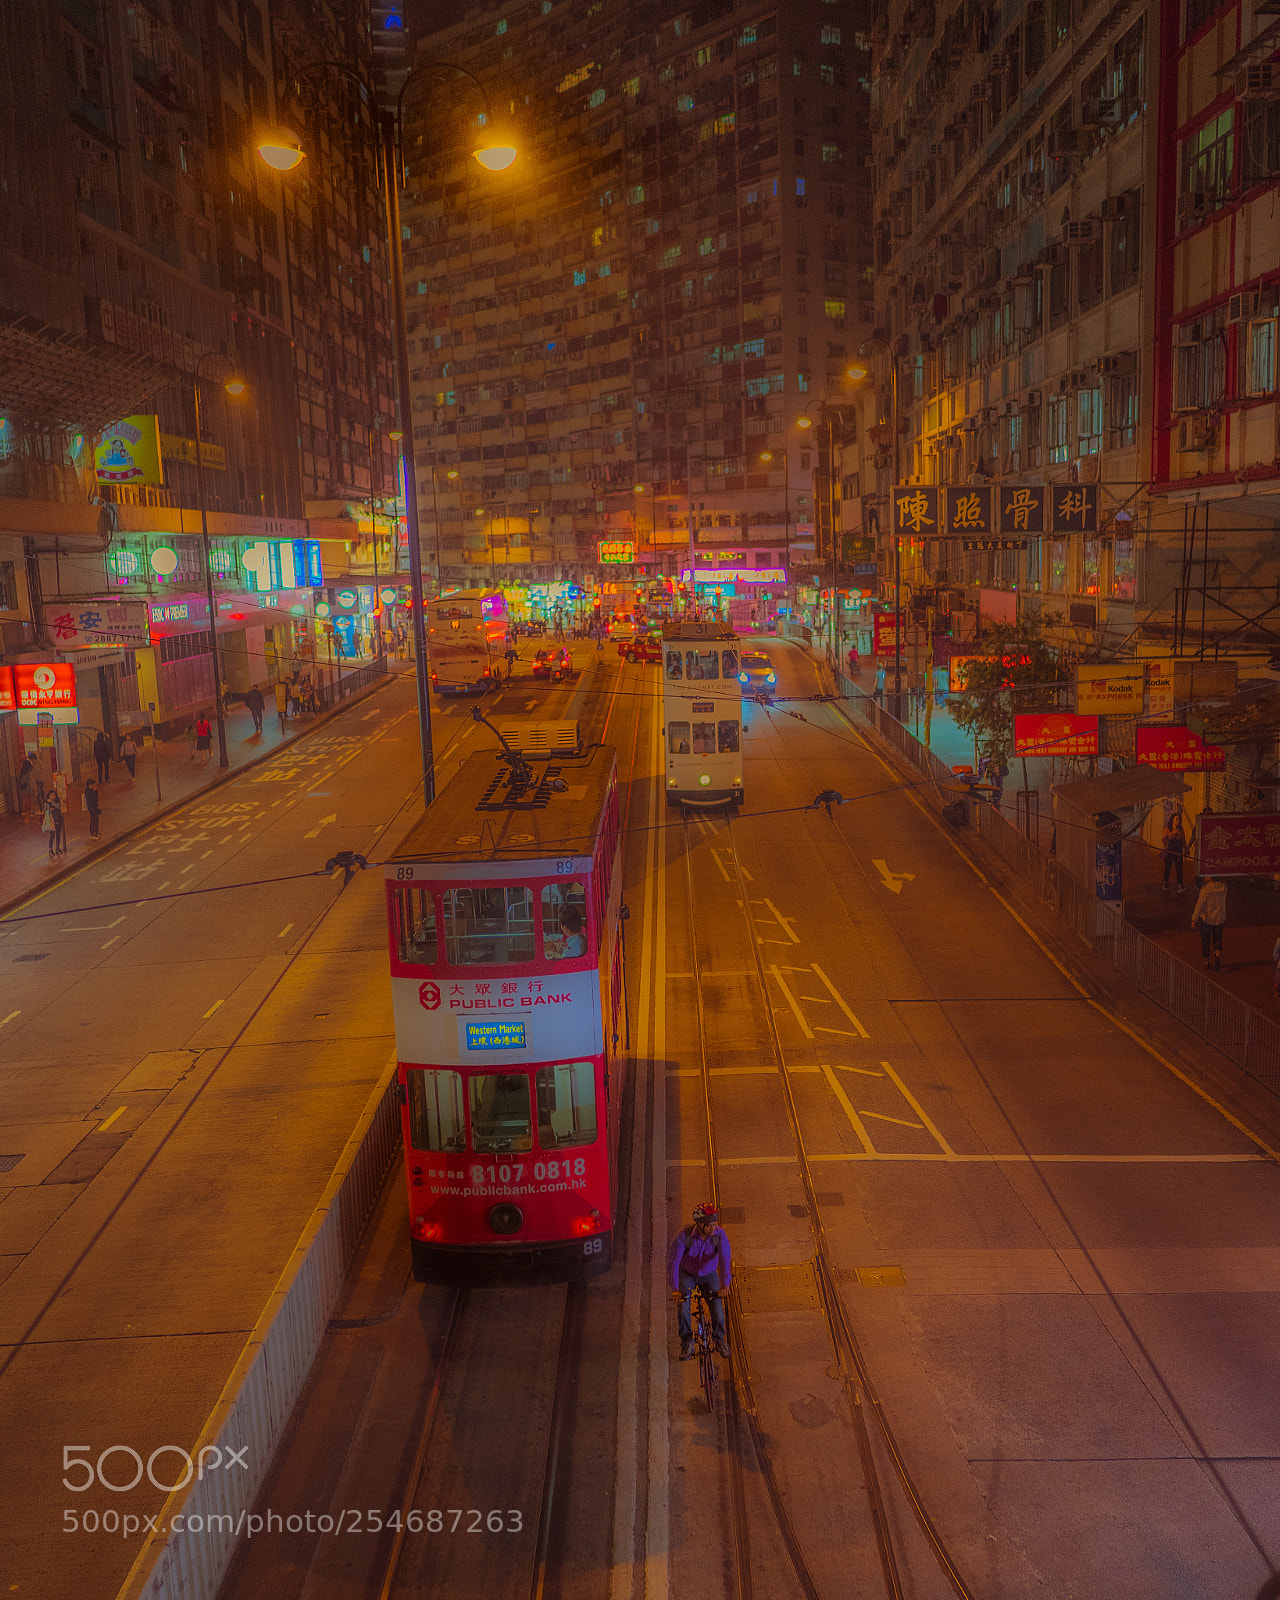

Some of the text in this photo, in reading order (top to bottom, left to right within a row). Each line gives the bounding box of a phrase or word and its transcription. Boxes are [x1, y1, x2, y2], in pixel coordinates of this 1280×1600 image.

[896, 488, 1092, 533] 陳照骨科
[695, 624, 708, 634] 31
[1108, 684, 1134, 692] Kodak
[1146, 679, 1171, 687] Kodak
[189, 801, 261, 816] BUS
[154, 815, 252, 833] STOP
[397, 867, 414, 880] 89
[556, 861, 573, 875] 89
[449, 980, 544, 997] 大眾銀行
[449, 992, 573, 1010] PUBLIC BANK
[468, 1024, 525, 1036] Western Market
[471, 1163, 525, 1184] 8107
[533, 1157, 586, 1181] 0818
[430, 1178, 587, 1198] www.publicbank.com.hk
[583, 1238, 603, 1256] 89
